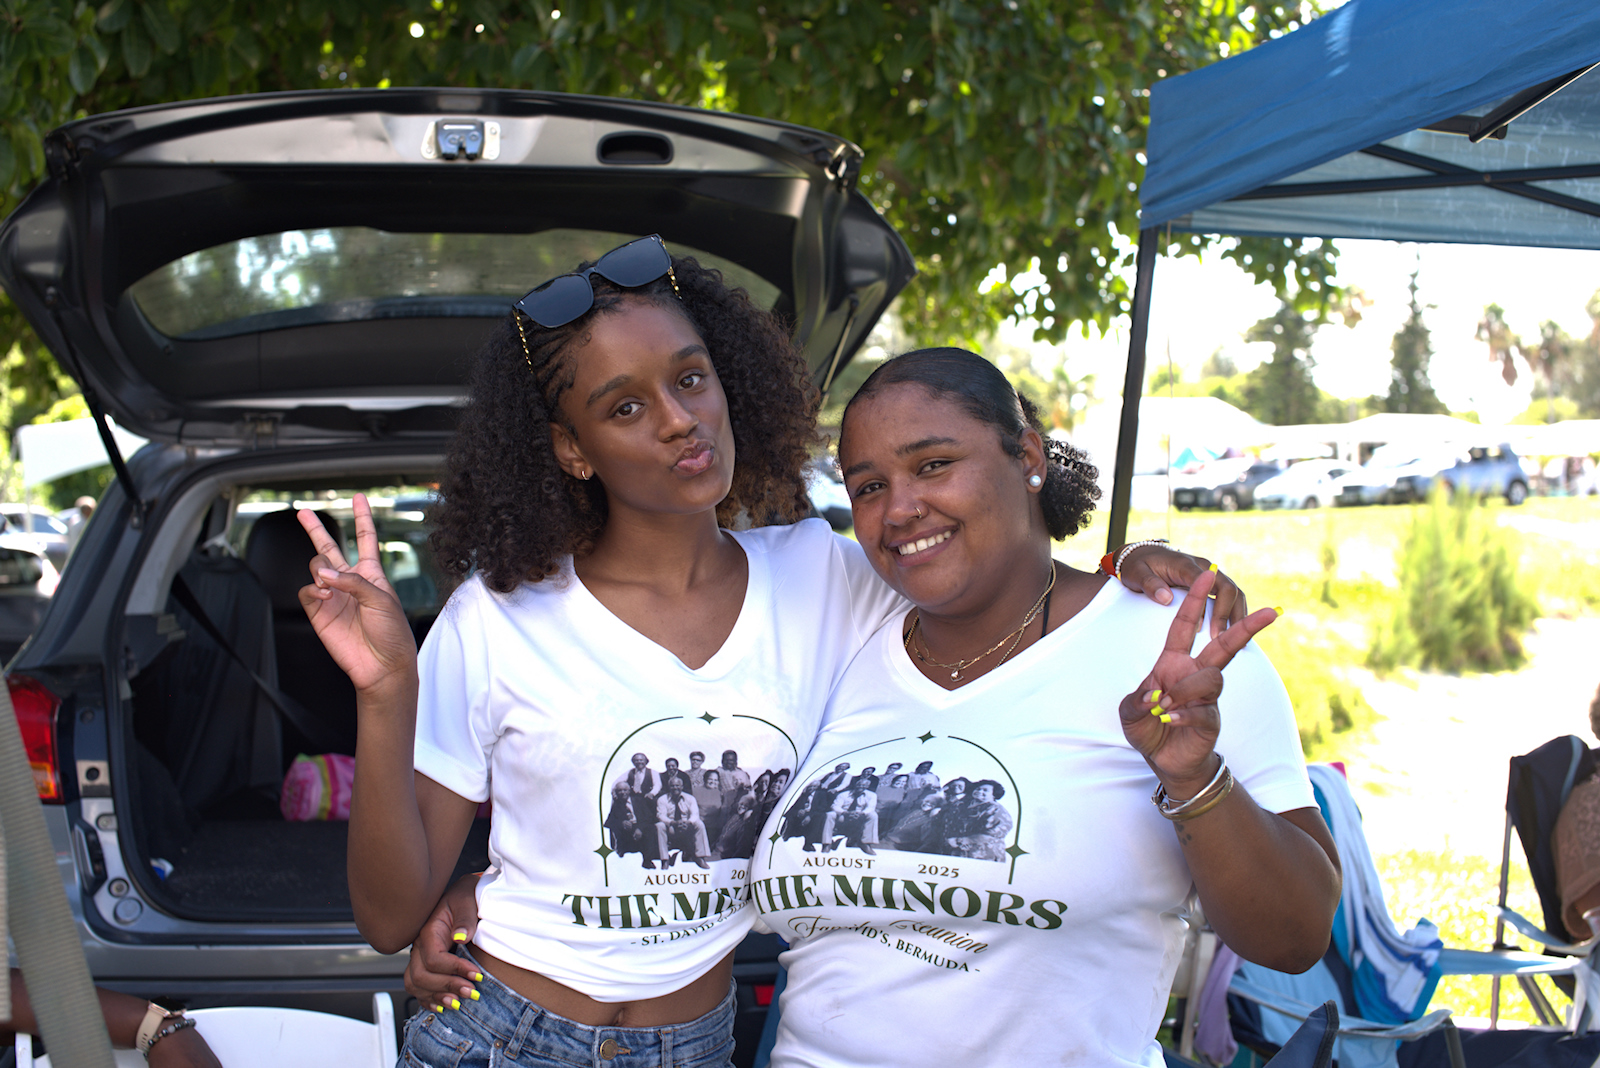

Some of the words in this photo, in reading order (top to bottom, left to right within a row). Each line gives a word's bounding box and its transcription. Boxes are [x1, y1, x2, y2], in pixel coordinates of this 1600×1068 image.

[644, 873, 710, 886] AUGUST
[731, 869, 749, 880] 20
[803, 857, 875, 869] AUGUST
[917, 863, 960, 879] 2025
[561, 893, 667, 929] THE
[751, 874, 824, 915] THE
[831, 874, 1069, 931] MINORS
[641, 934, 664, 946] ST.
[895, 938, 970, 973] BERMUDA
